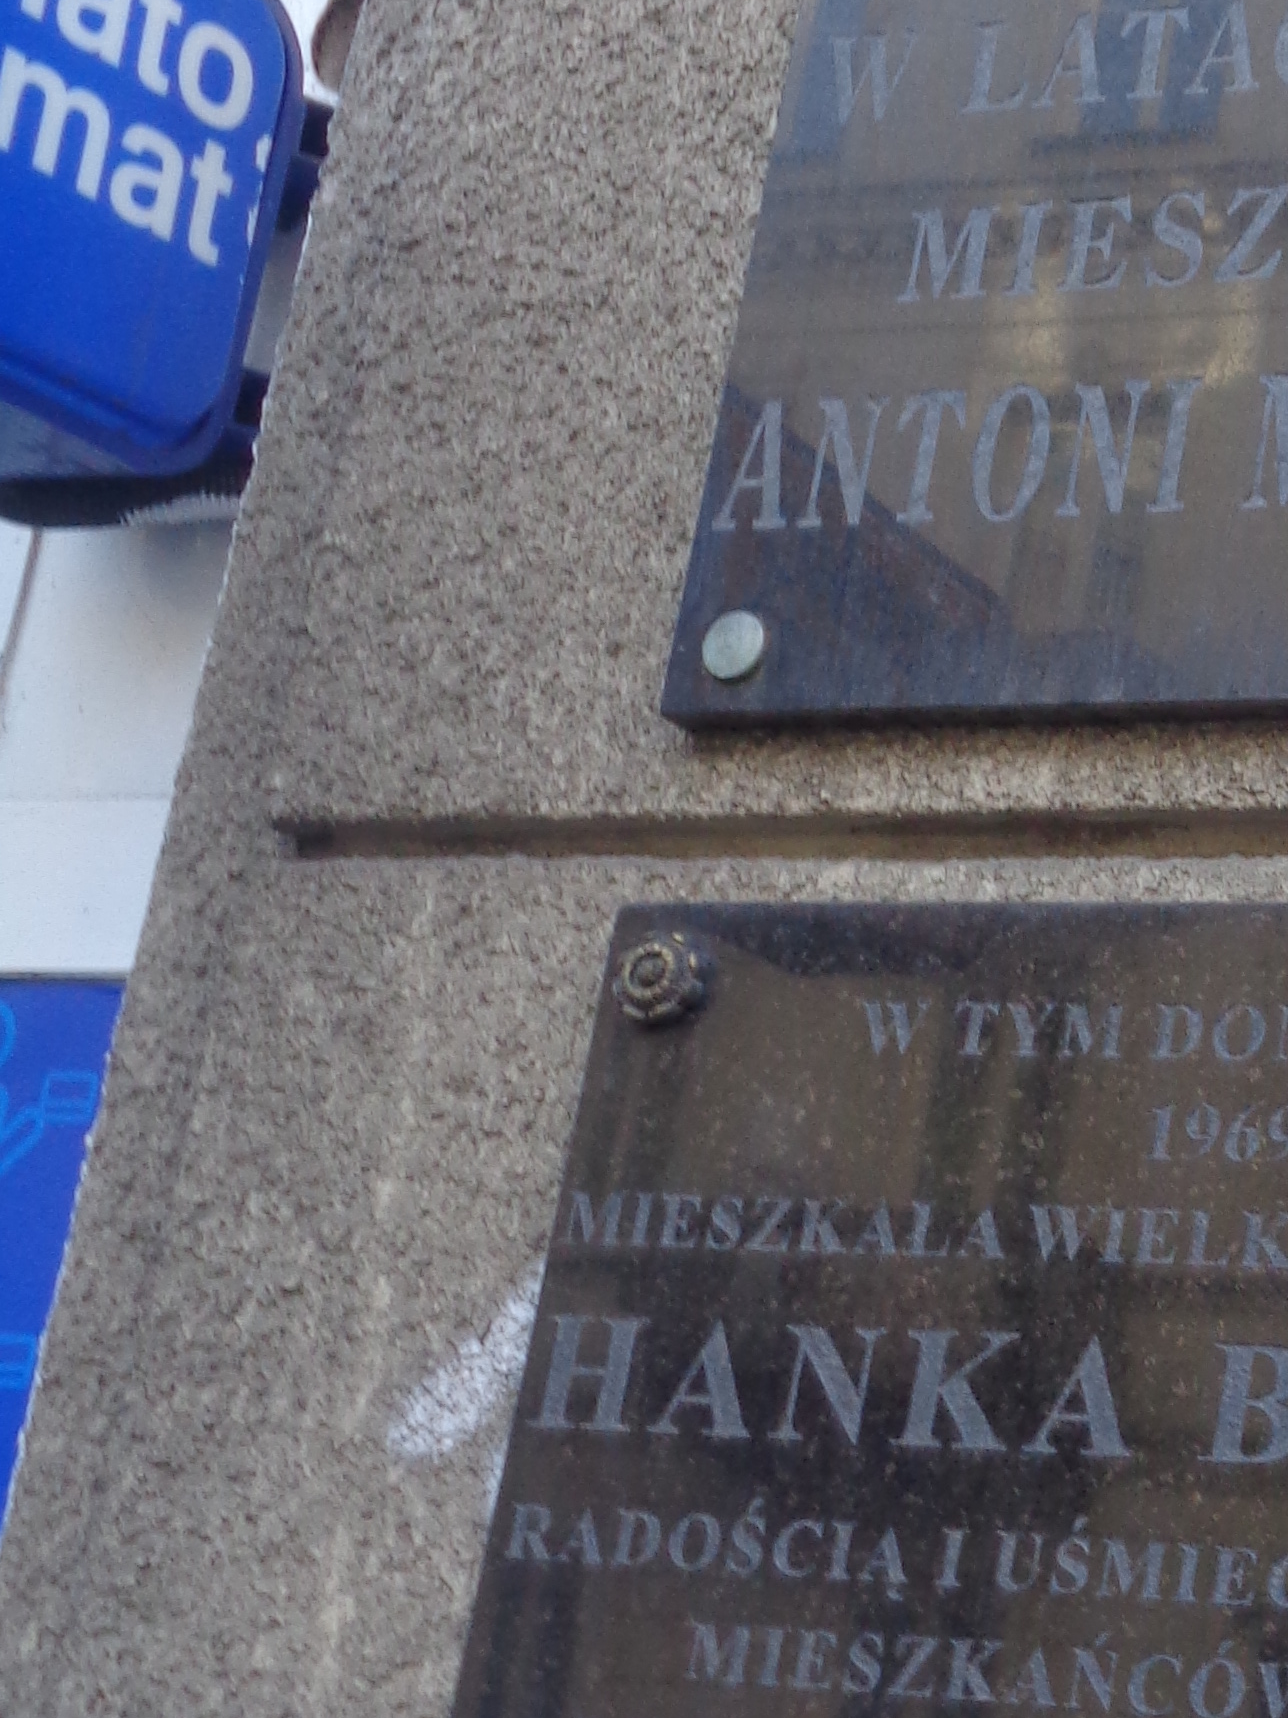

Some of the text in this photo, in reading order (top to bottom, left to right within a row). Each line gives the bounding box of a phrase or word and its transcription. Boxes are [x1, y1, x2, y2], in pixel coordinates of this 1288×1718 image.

[829, 28, 920, 126] W
[711, 376, 1208, 532] ANTONI
[862, 1000, 930, 1058] W
[954, 998, 1125, 1061] TYM
[527, 1312, 1134, 1460] HANKA
[503, 1497, 910, 1604] RADOŚCIĄ
[935, 1526, 969, 1590] I
